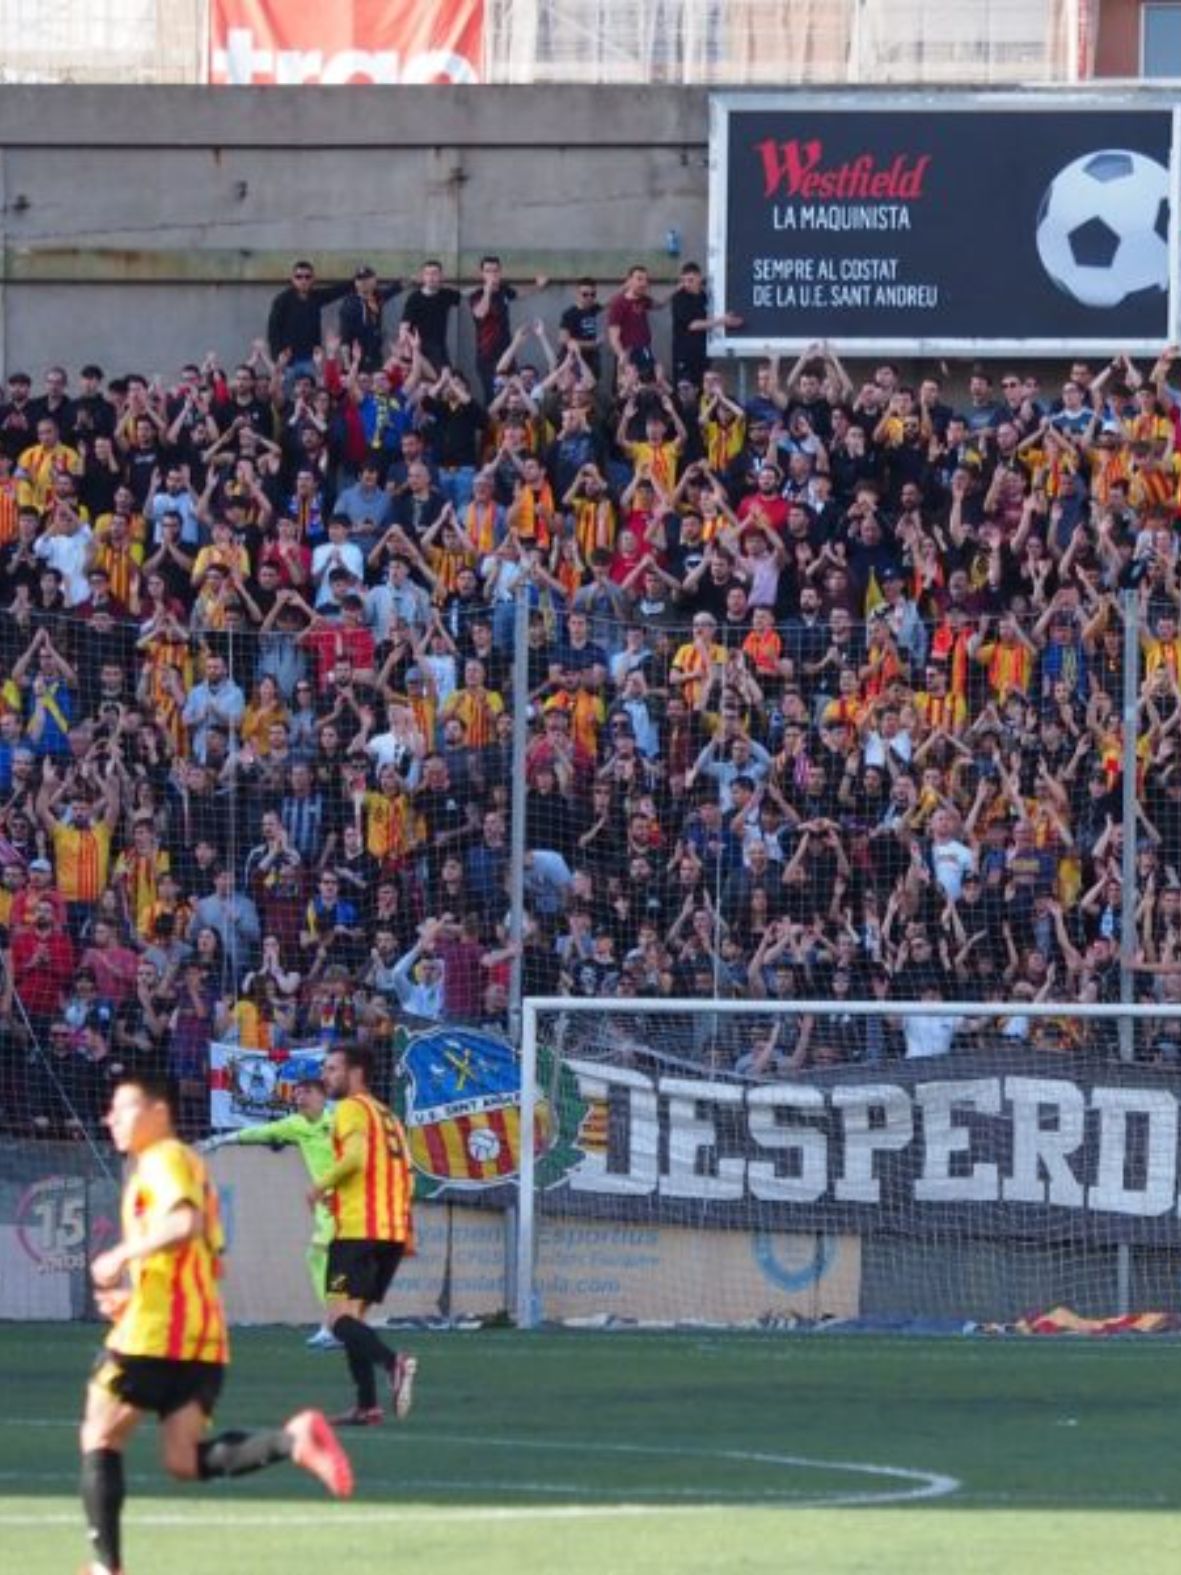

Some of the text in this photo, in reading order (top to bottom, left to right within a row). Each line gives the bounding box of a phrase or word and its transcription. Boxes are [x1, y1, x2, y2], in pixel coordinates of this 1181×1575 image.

[754, 137, 932, 200] Westfield
[773, 205, 911, 232] LA MAQUINISTA
[753, 259, 898, 281] SEMPRE AL COSTAT
[753, 285, 938, 308] DE LA U.E. SANT ANDREU
